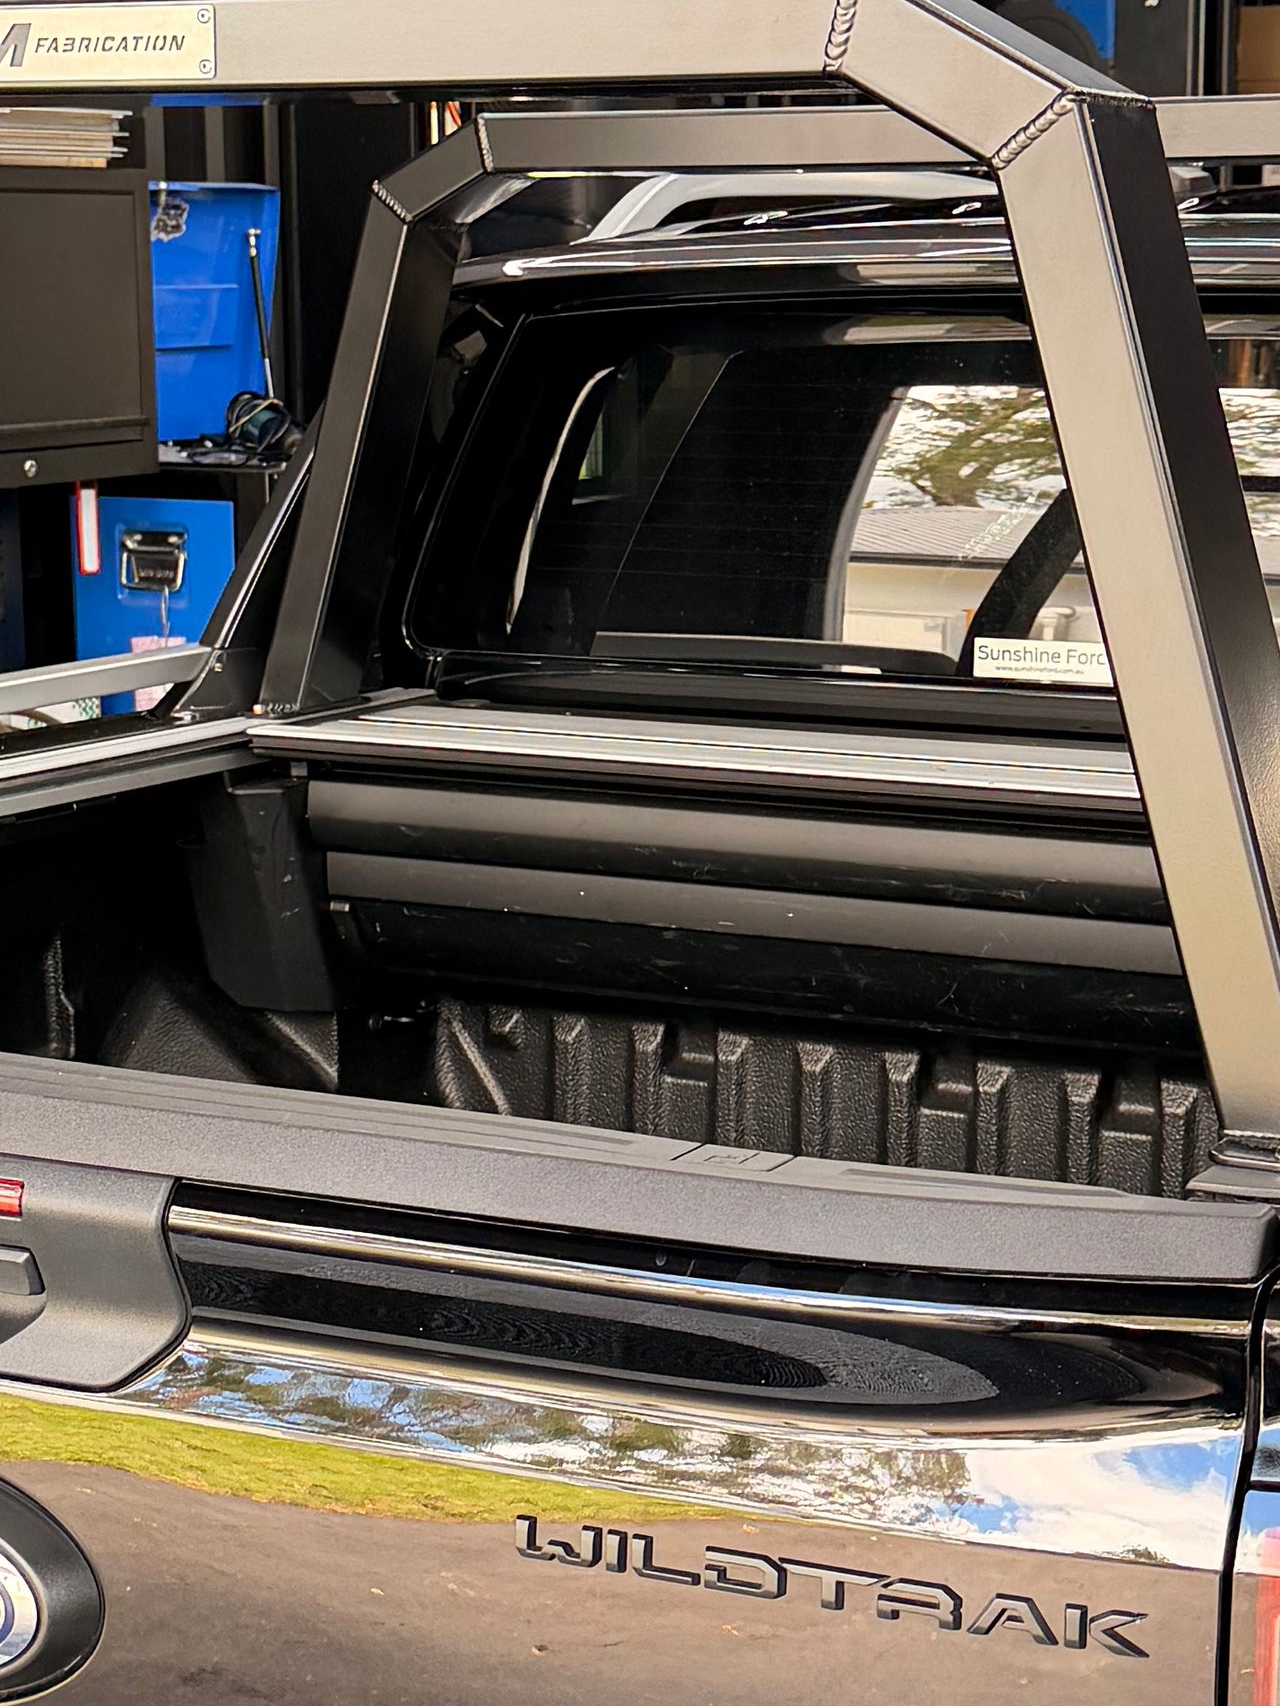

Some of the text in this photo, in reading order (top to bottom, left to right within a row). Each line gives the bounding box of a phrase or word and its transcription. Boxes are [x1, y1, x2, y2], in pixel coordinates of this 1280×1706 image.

[34, 34, 186, 55] FABRICATION
[977, 644, 1062, 664] Sunshine
[514, 1513, 1151, 1660] WILDTRAK
